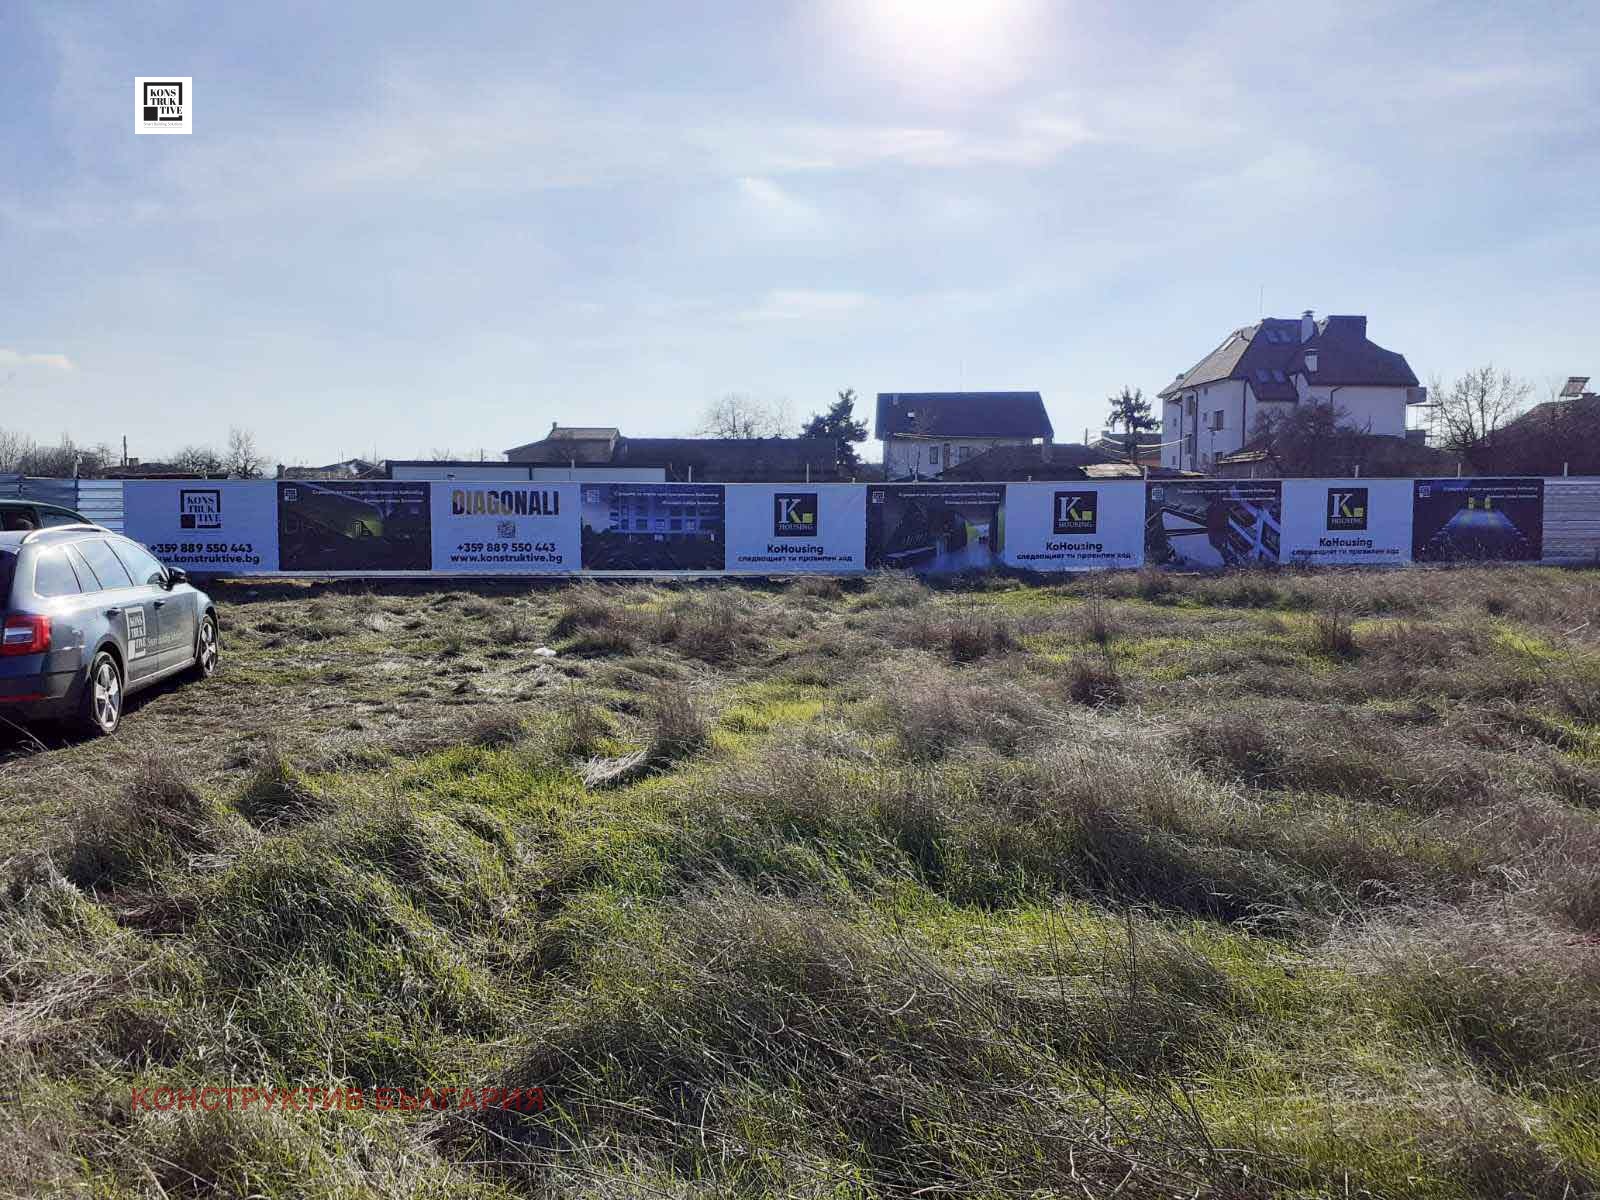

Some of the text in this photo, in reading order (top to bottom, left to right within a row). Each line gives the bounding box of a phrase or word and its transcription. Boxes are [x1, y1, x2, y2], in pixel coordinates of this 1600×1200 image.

[187, 495, 215, 505] KONS
[452, 489, 560, 516] DIAGONALI
[150, 543, 253, 553] +359 889 550 443
[457, 543, 556, 553] +359 889 550 443
[767, 543, 824, 555] KoHousing
[1046, 541, 1103, 553] KoHousing
[450, 553, 563, 565] www.konstruktive.bg
